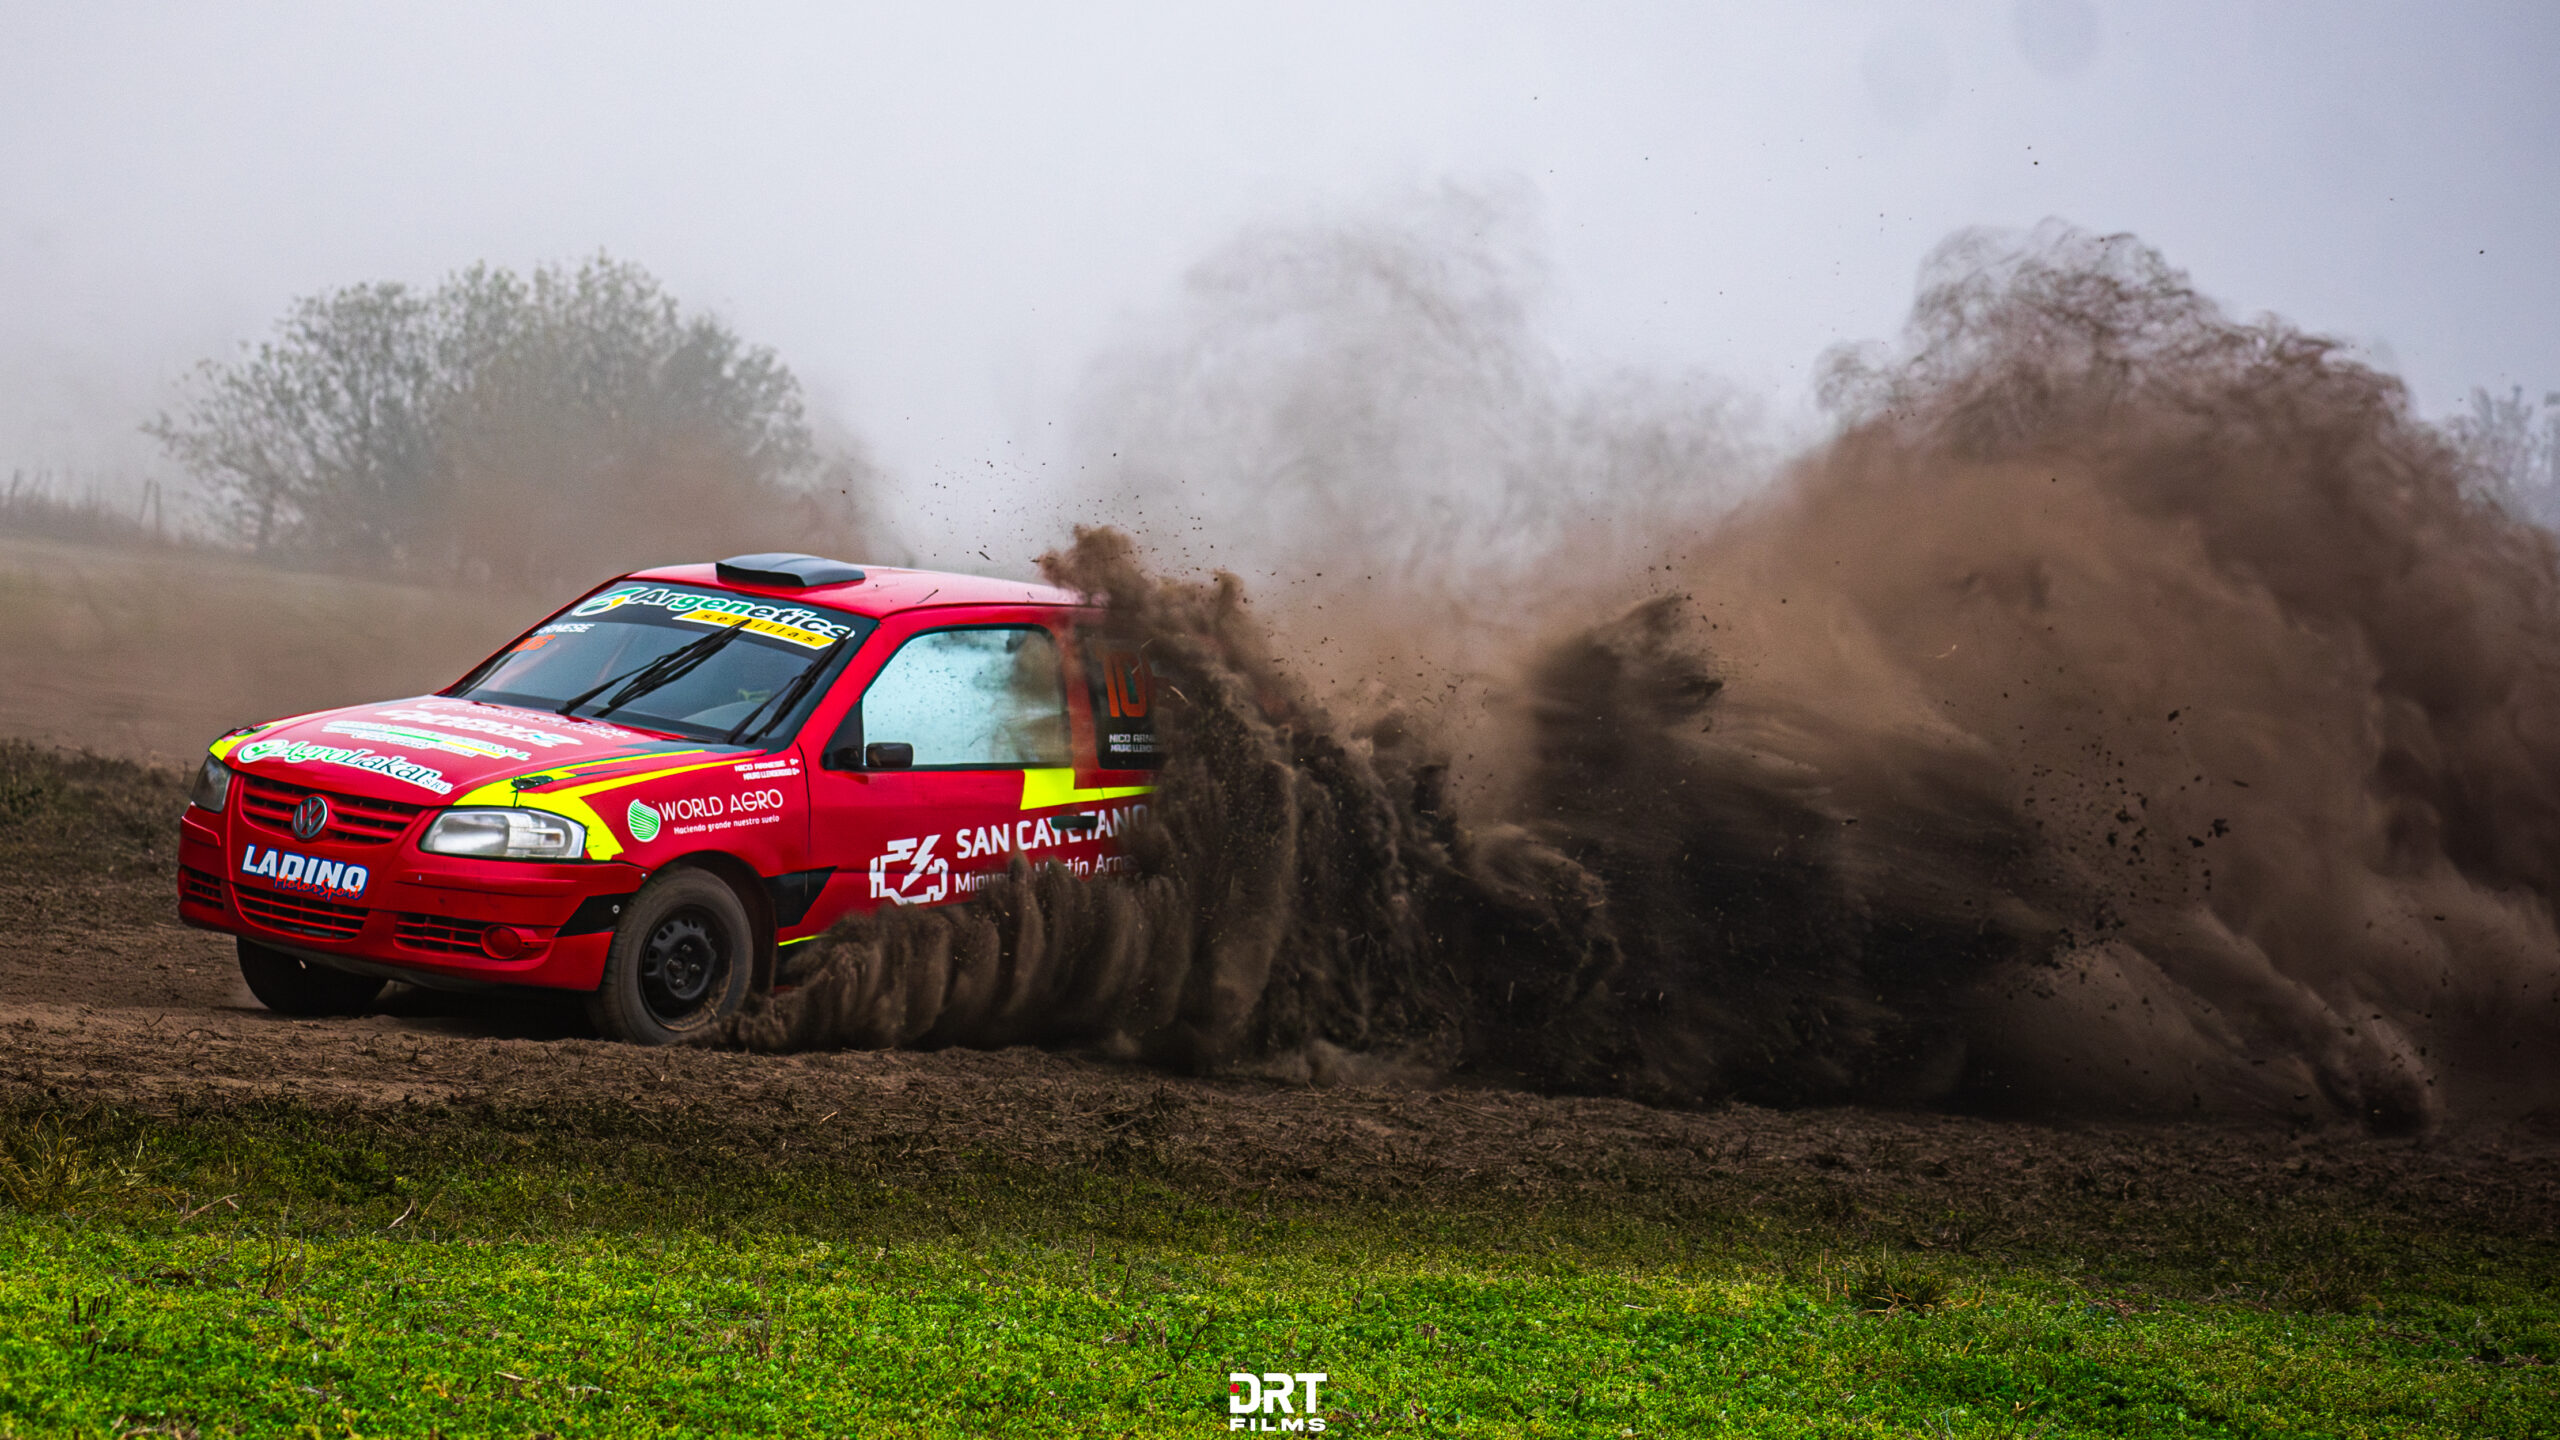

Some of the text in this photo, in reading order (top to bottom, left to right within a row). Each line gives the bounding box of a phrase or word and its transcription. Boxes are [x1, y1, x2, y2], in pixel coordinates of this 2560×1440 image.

[635, 588, 855, 640] Argenetics
[272, 743, 438, 784] AgroLakar
[658, 788, 784, 822] WORLD AGRO
[673, 813, 780, 836] Haciendo grande nuestro suelo
[955, 804, 1148, 860] SAN CAYETANO
[242, 844, 368, 893] LADINO
[274, 871, 362, 900] MotorSport
